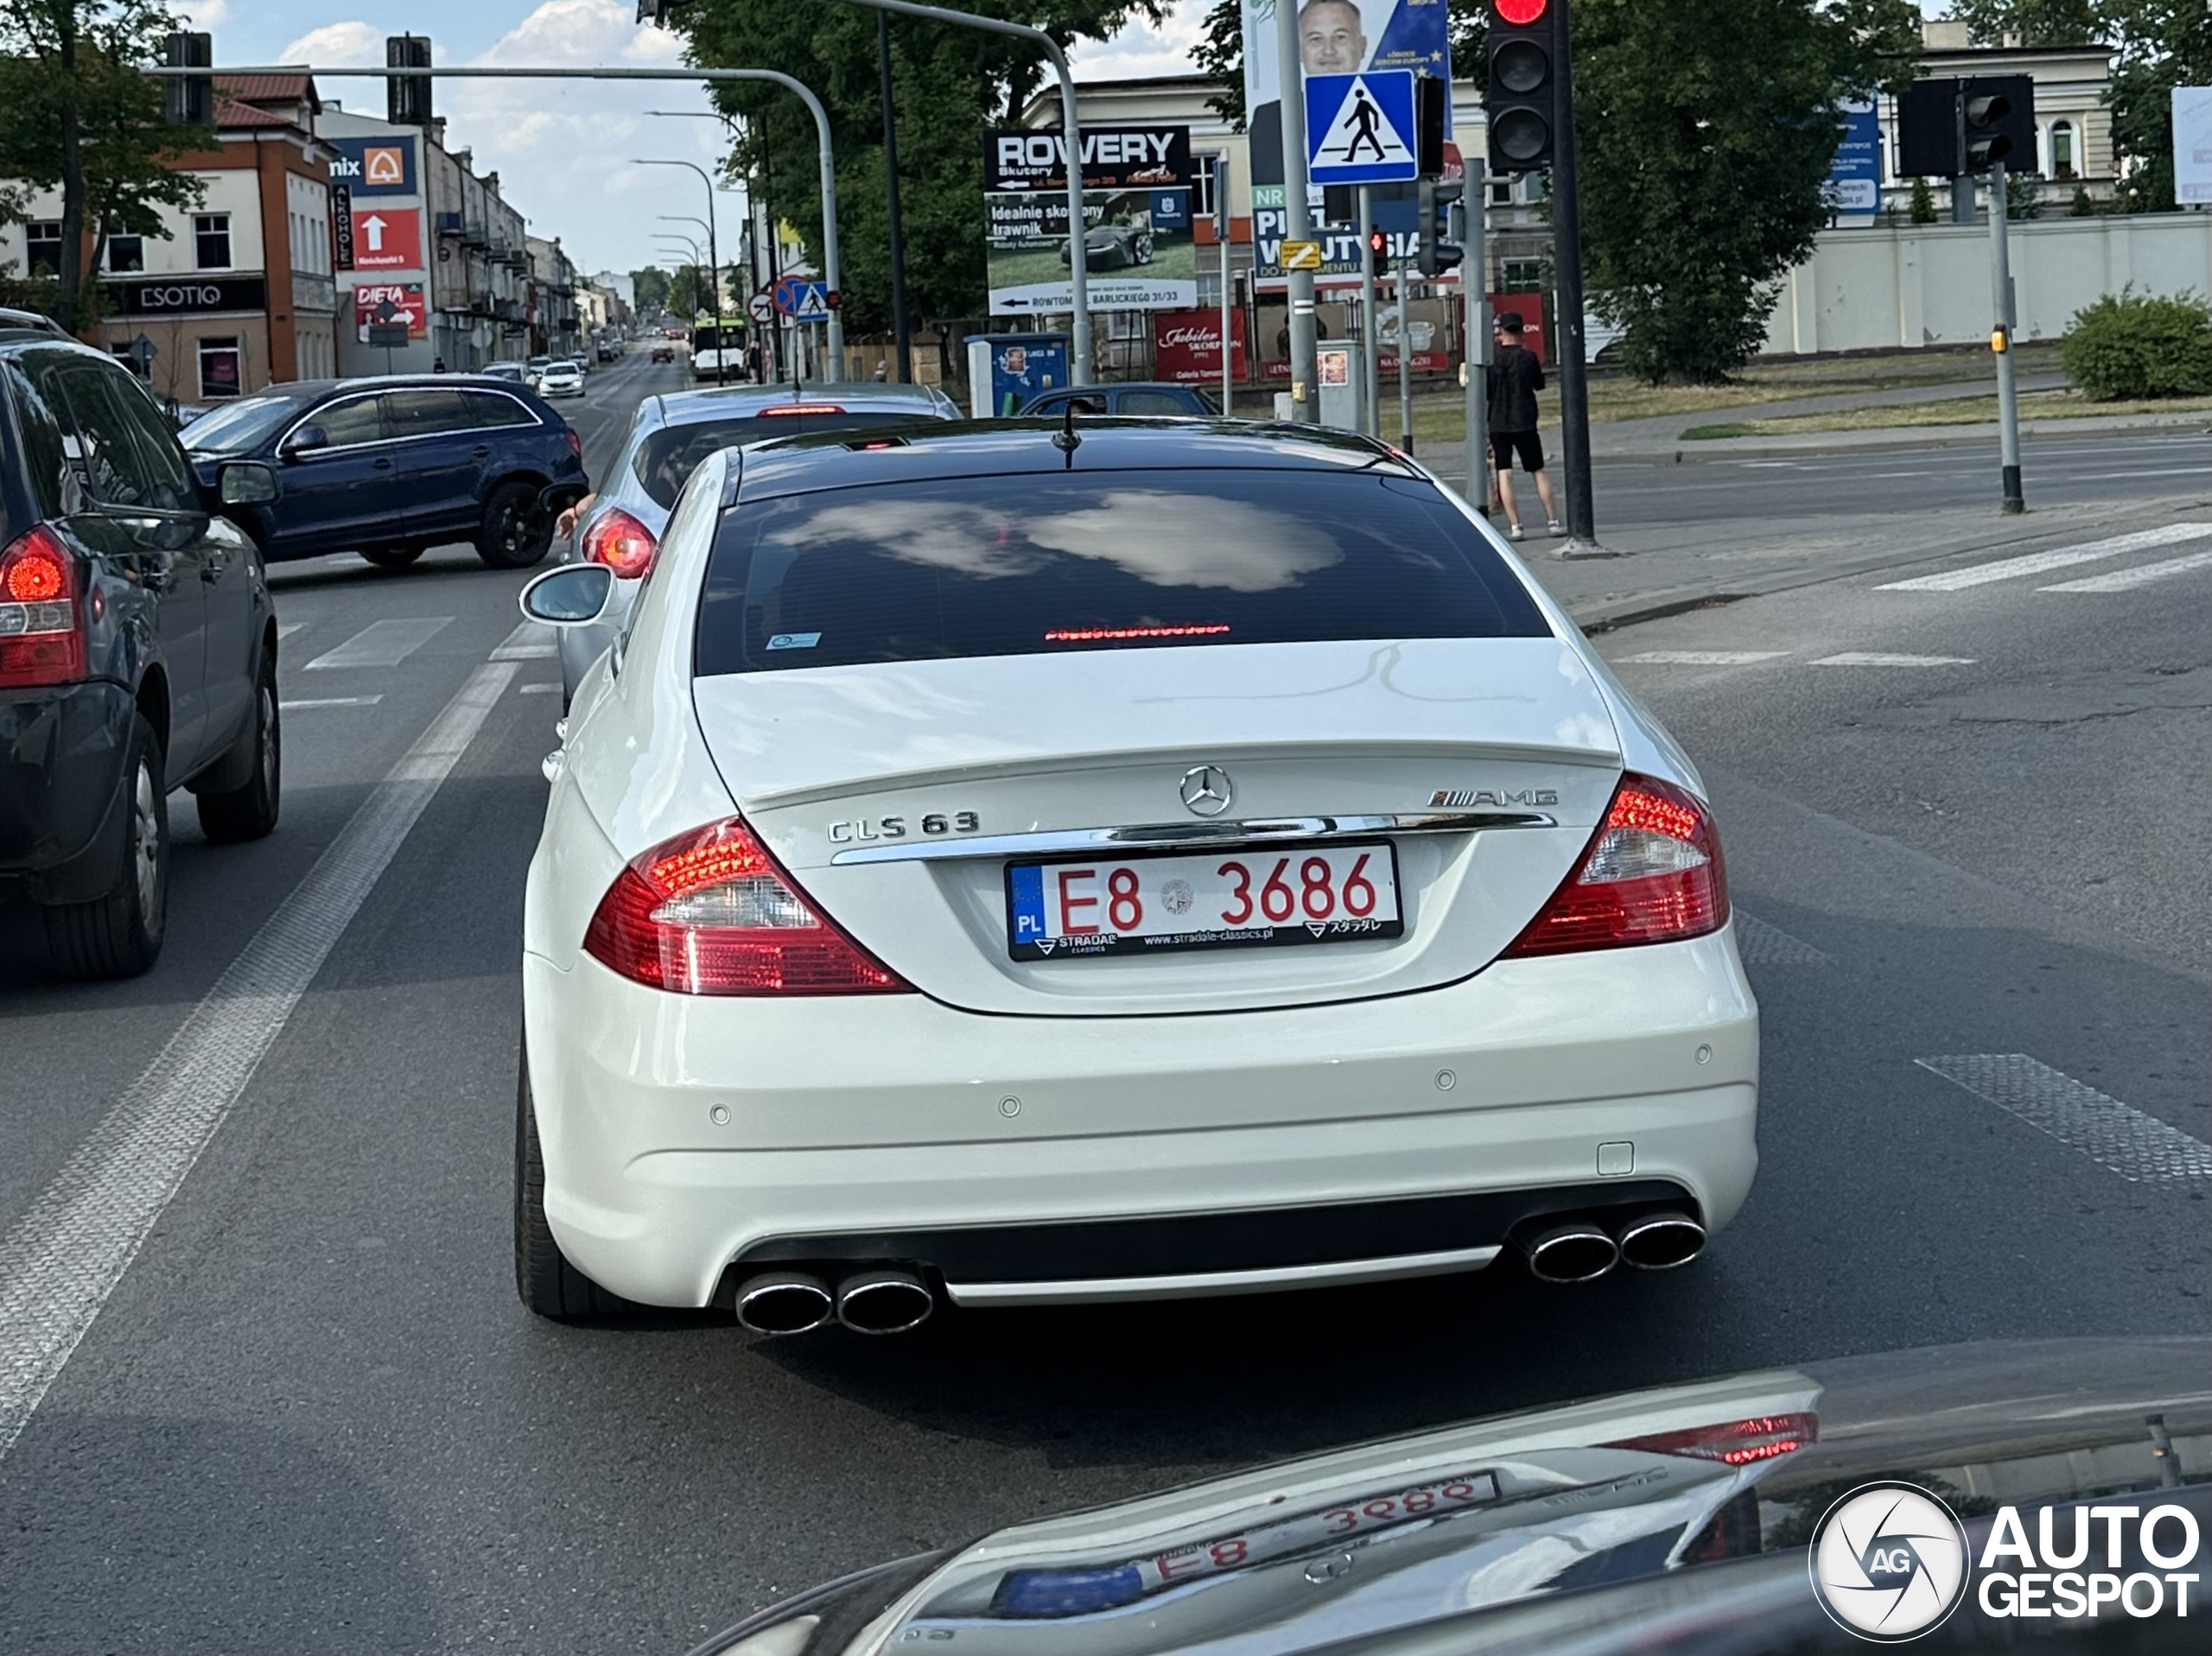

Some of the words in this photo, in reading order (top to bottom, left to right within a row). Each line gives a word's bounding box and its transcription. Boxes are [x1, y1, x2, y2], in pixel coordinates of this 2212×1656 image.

[998, 133, 1175, 167] ROWERY
[999, 167, 1052, 177] Skutery
[1444, 162, 1463, 180] TOP
[1256, 189, 1283, 205] NR
[992, 206, 1042, 220] Idealnie
[1046, 204, 1104, 220] skoony
[336, 186, 351, 263] ALKOHOLE
[993, 223, 1042, 236] trawnik
[1261, 266, 1279, 276] DO
[141, 286, 221, 307] ESOTIQ
[357, 287, 404, 304] DIETA
[1033, 297, 1073, 307] ROWTOM
[1093, 293, 1150, 304] BARLICKIEGO
[1152, 291, 1178, 301] 31/33
[1189, 339, 1242, 351] SKORPN
[828, 815, 906, 843] CLS
[921, 810, 980, 835] 63
[1058, 867, 1143, 936] E8
[1217, 853, 1376, 924] 3686
[1018, 915, 1041, 934] PL
[1145, 929, 1274, 946] www.stradale-classics.pl
